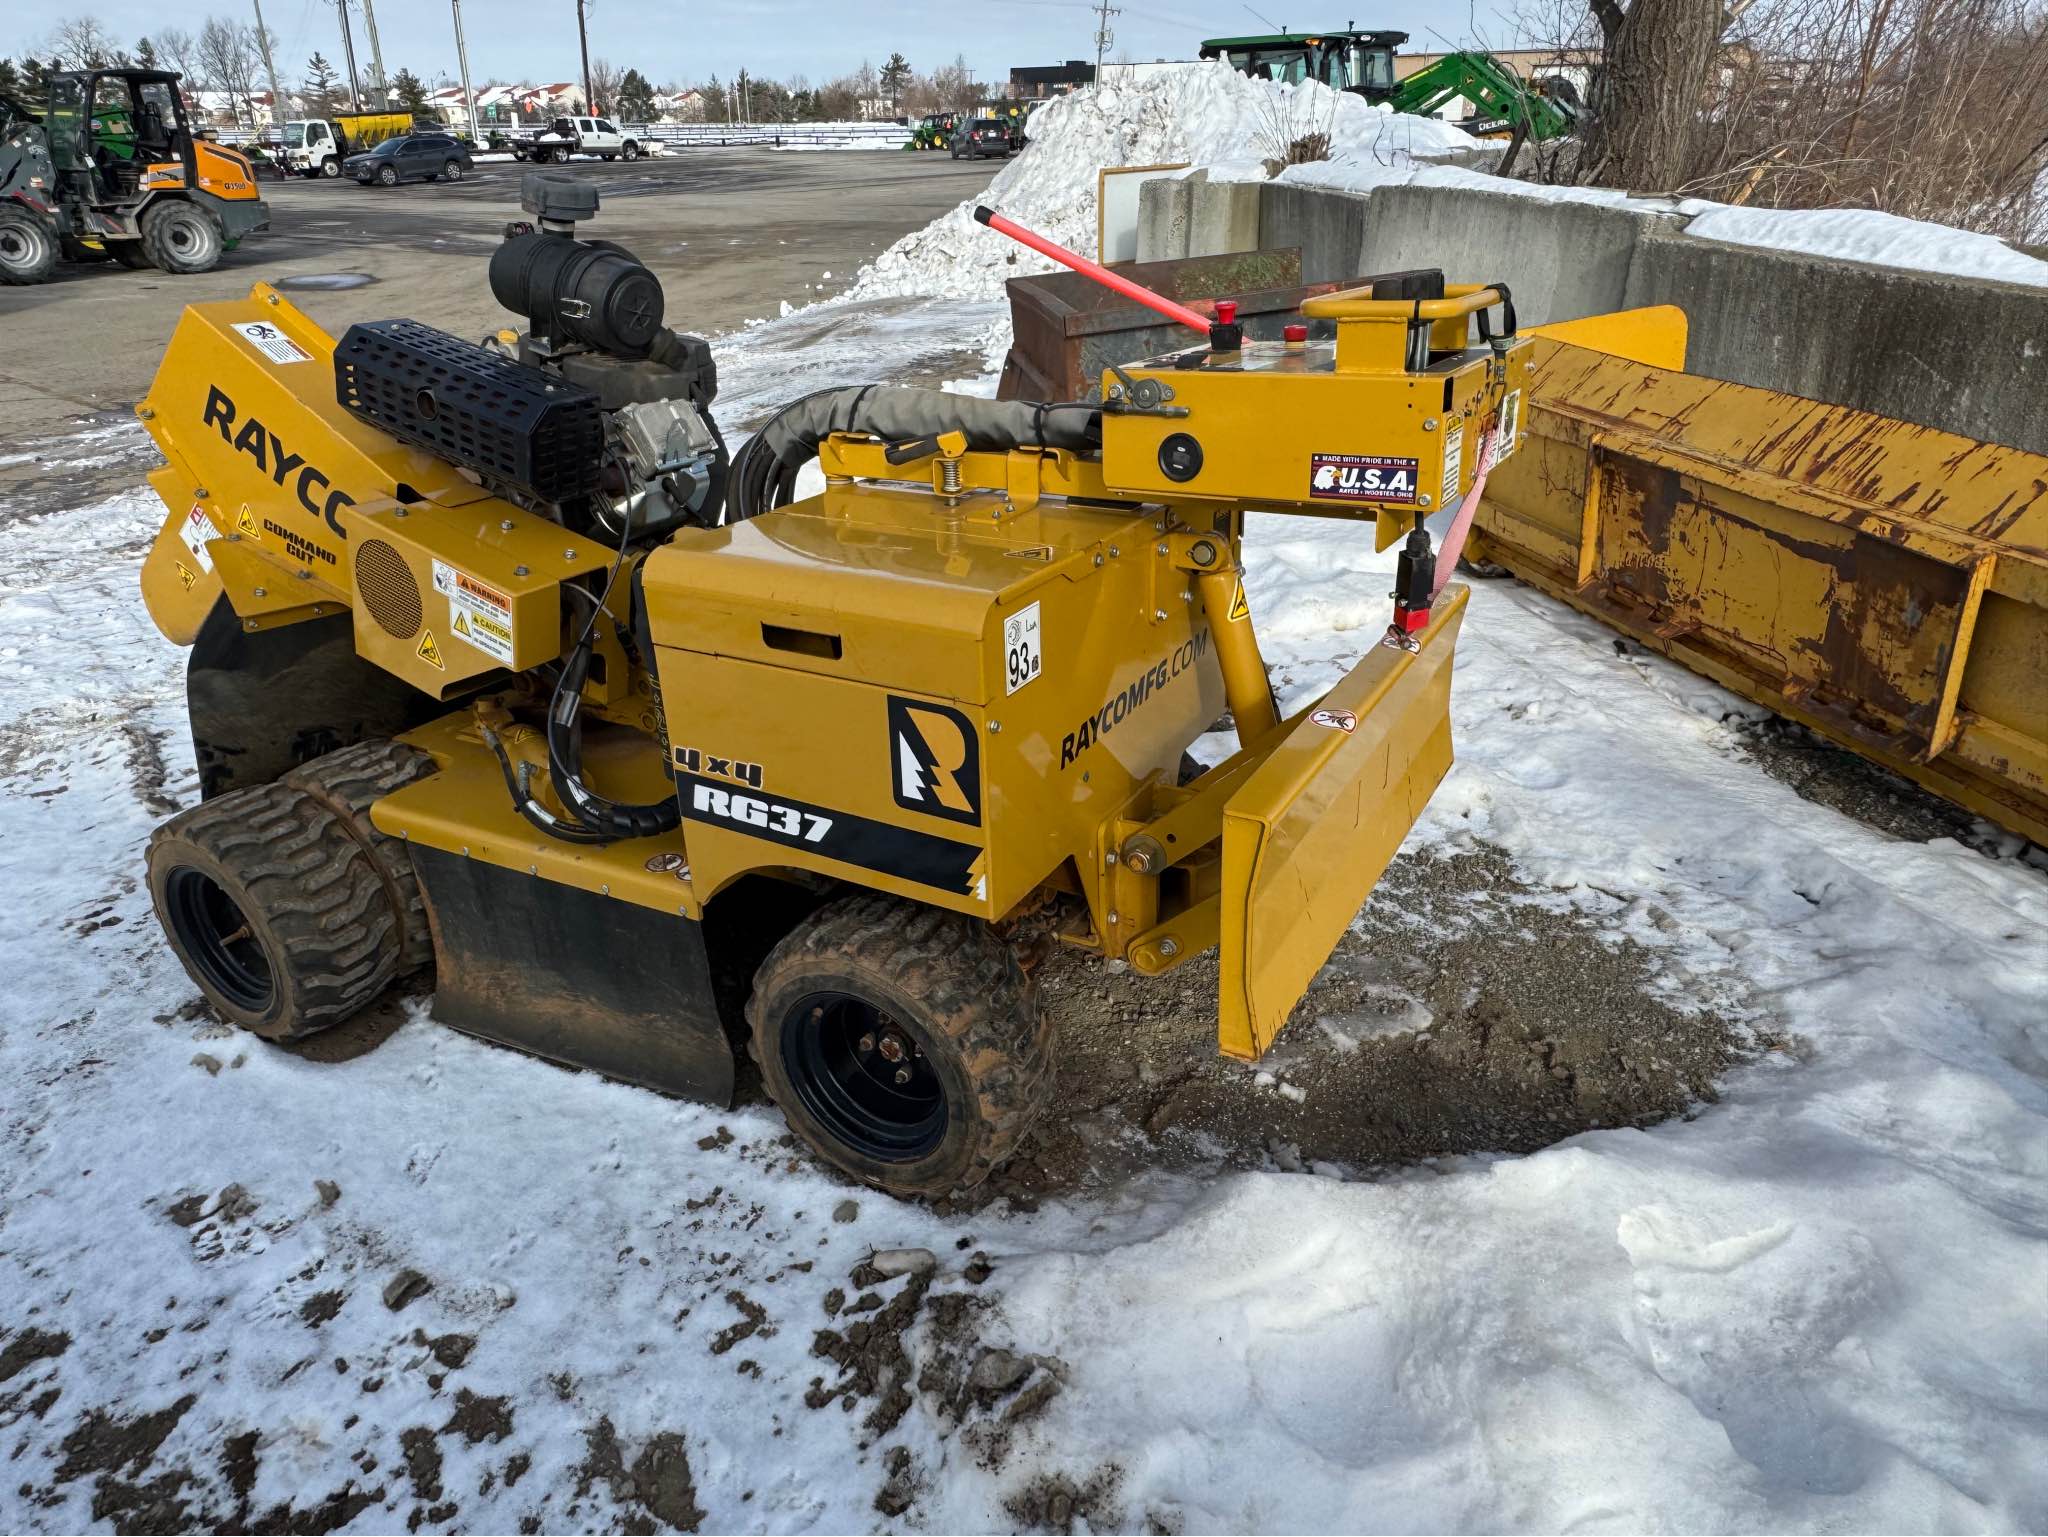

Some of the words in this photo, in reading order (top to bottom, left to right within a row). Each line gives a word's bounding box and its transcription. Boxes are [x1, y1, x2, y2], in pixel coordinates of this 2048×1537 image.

[1322, 455, 1342, 463] MADE
[1361, 457, 1382, 465] PRIDE
[1339, 467, 1415, 491] U.S.A.
[263, 518, 337, 565] COMMAND
[286, 542, 316, 566] CUT
[470, 582, 506, 608] WARNING
[480, 617, 511, 640] CAUTION
[1009, 642, 1030, 687] 93
[1060, 626, 1208, 771] RAYCOMFG.COM
[693, 783, 833, 843] RG37
